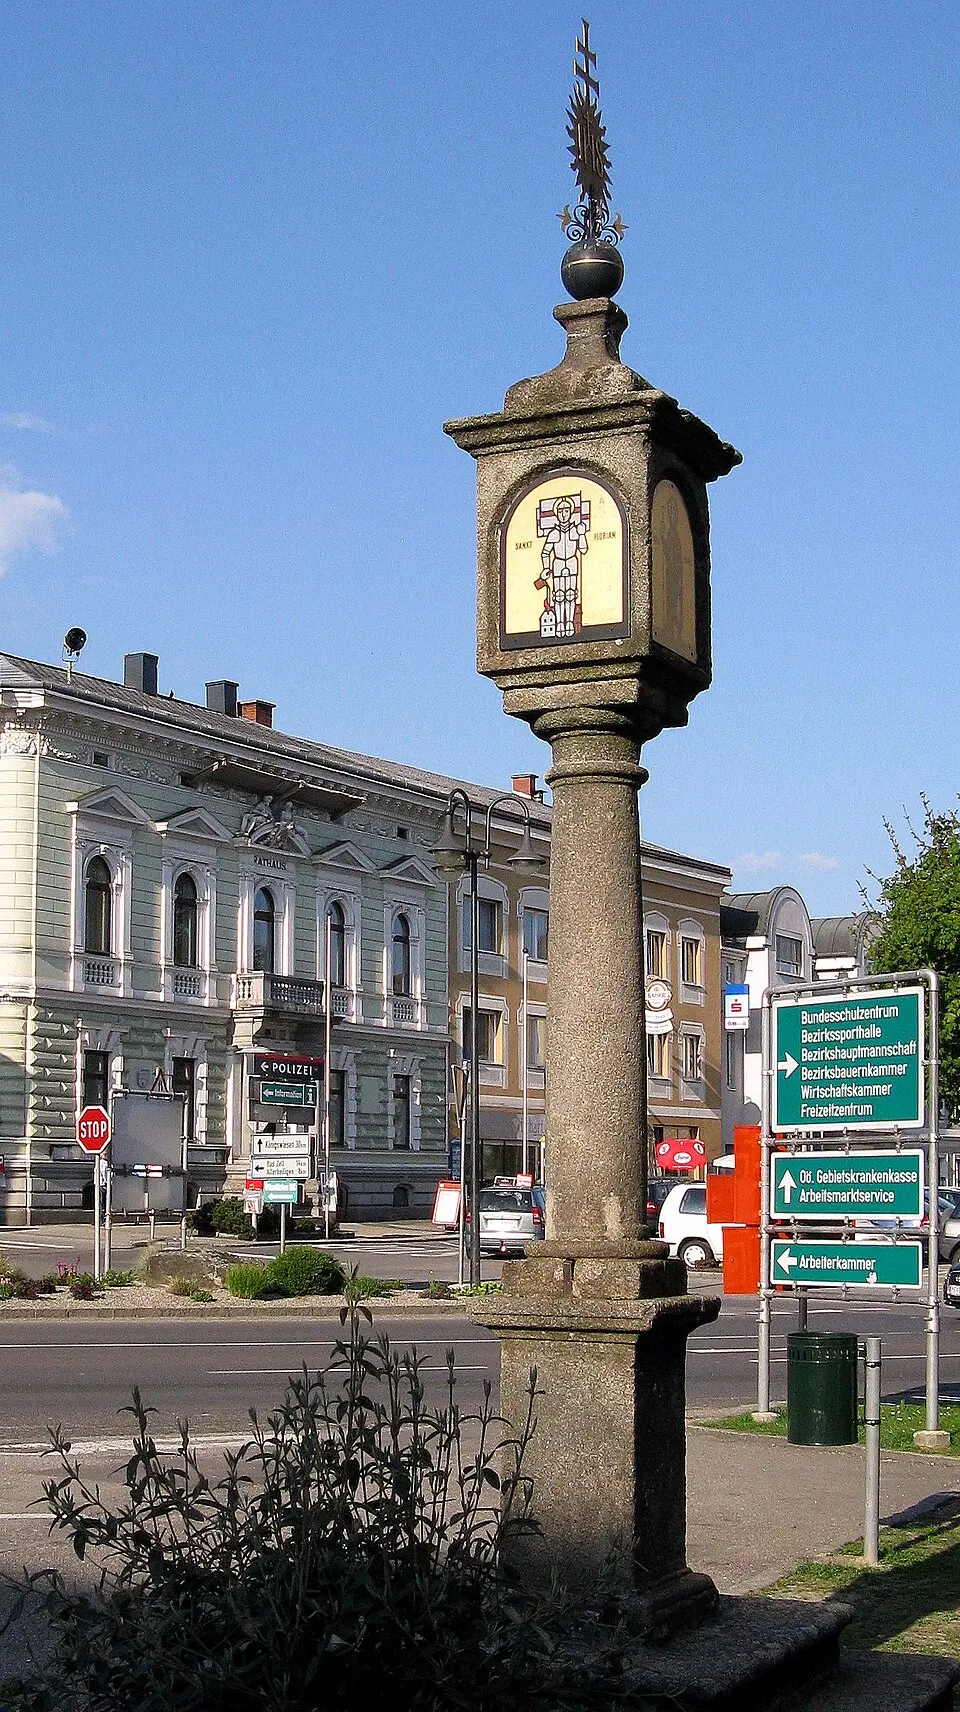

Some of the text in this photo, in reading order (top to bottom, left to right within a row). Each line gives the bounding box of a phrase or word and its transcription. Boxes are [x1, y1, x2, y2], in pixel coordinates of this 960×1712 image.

[515, 531, 617, 550] SANKT FLORIAN
[253, 855, 287, 870] RATHAUS
[801, 1005, 899, 1025] Bundesschulzentrum
[801, 1024, 882, 1043] Bezirkssporthalle
[801, 1040, 917, 1062] Bezirkshauptmannschaft
[272, 1062, 313, 1076] POLIZEI
[801, 1062, 908, 1081] Bezirksbauernkammer
[801, 1083, 893, 1099] Wirtschaftskammer
[801, 1102, 873, 1118] Freizeitzentrum
[80, 1120, 107, 1139] STOP
[816, 1169, 918, 1184] Gebietskrankenkasse
[799, 1188, 895, 1203] Arbeitsmarktservice
[799, 1255, 877, 1270] Arbeiterkammer
